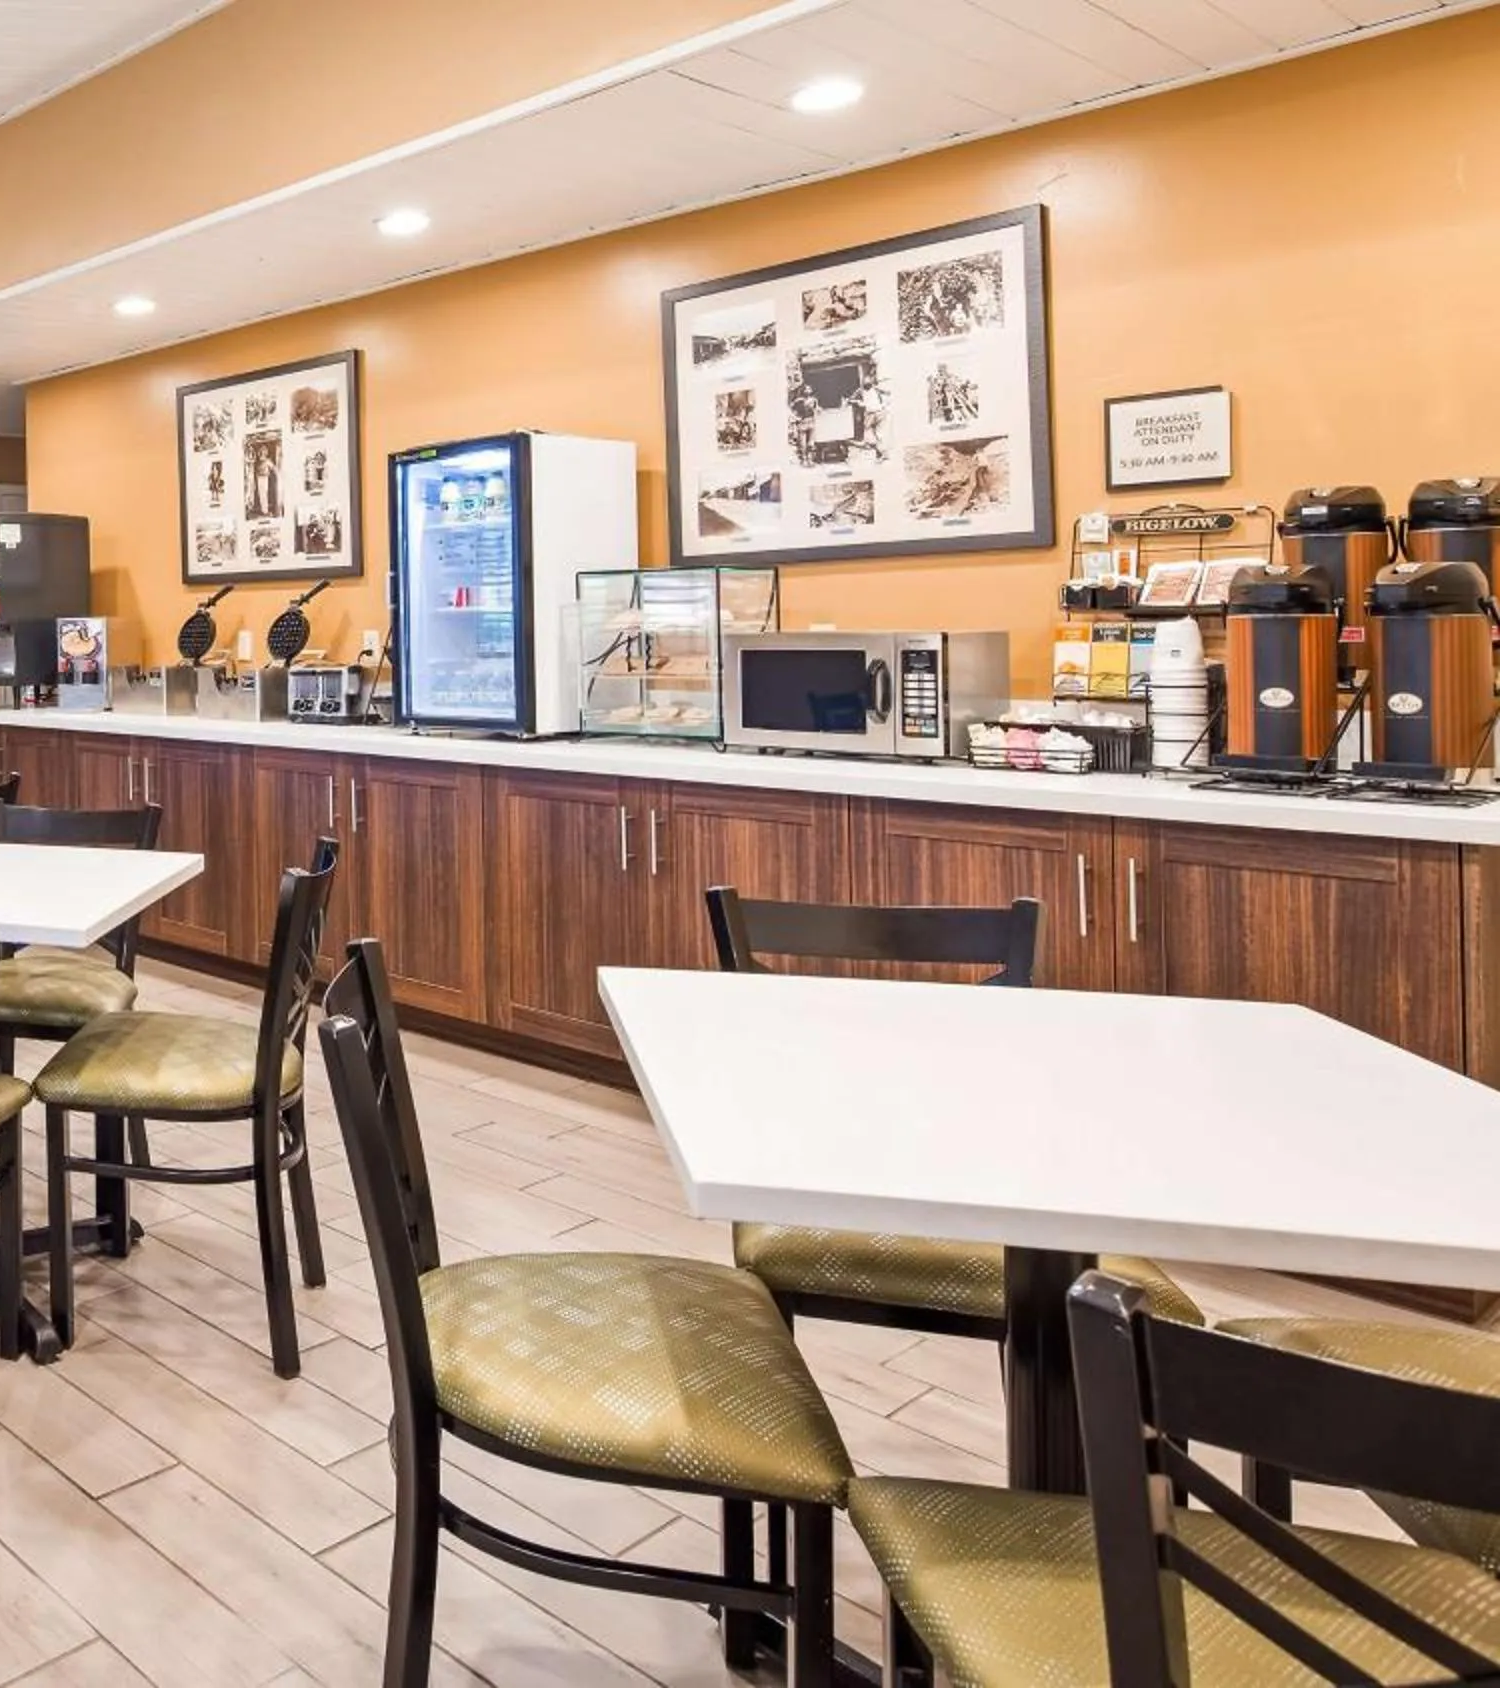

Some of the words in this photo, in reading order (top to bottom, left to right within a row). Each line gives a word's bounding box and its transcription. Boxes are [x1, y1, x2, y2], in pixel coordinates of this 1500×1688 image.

[1135, 412, 1201, 427] BREAKFAST
[1133, 421, 1202, 438] ATTENDANT
[1141, 436, 1159, 447] ON
[1161, 433, 1195, 446] DUTY
[1144, 456, 1165, 467] AM
[1196, 451, 1219, 462] AM
[1125, 517, 1219, 531] BIGELOW
